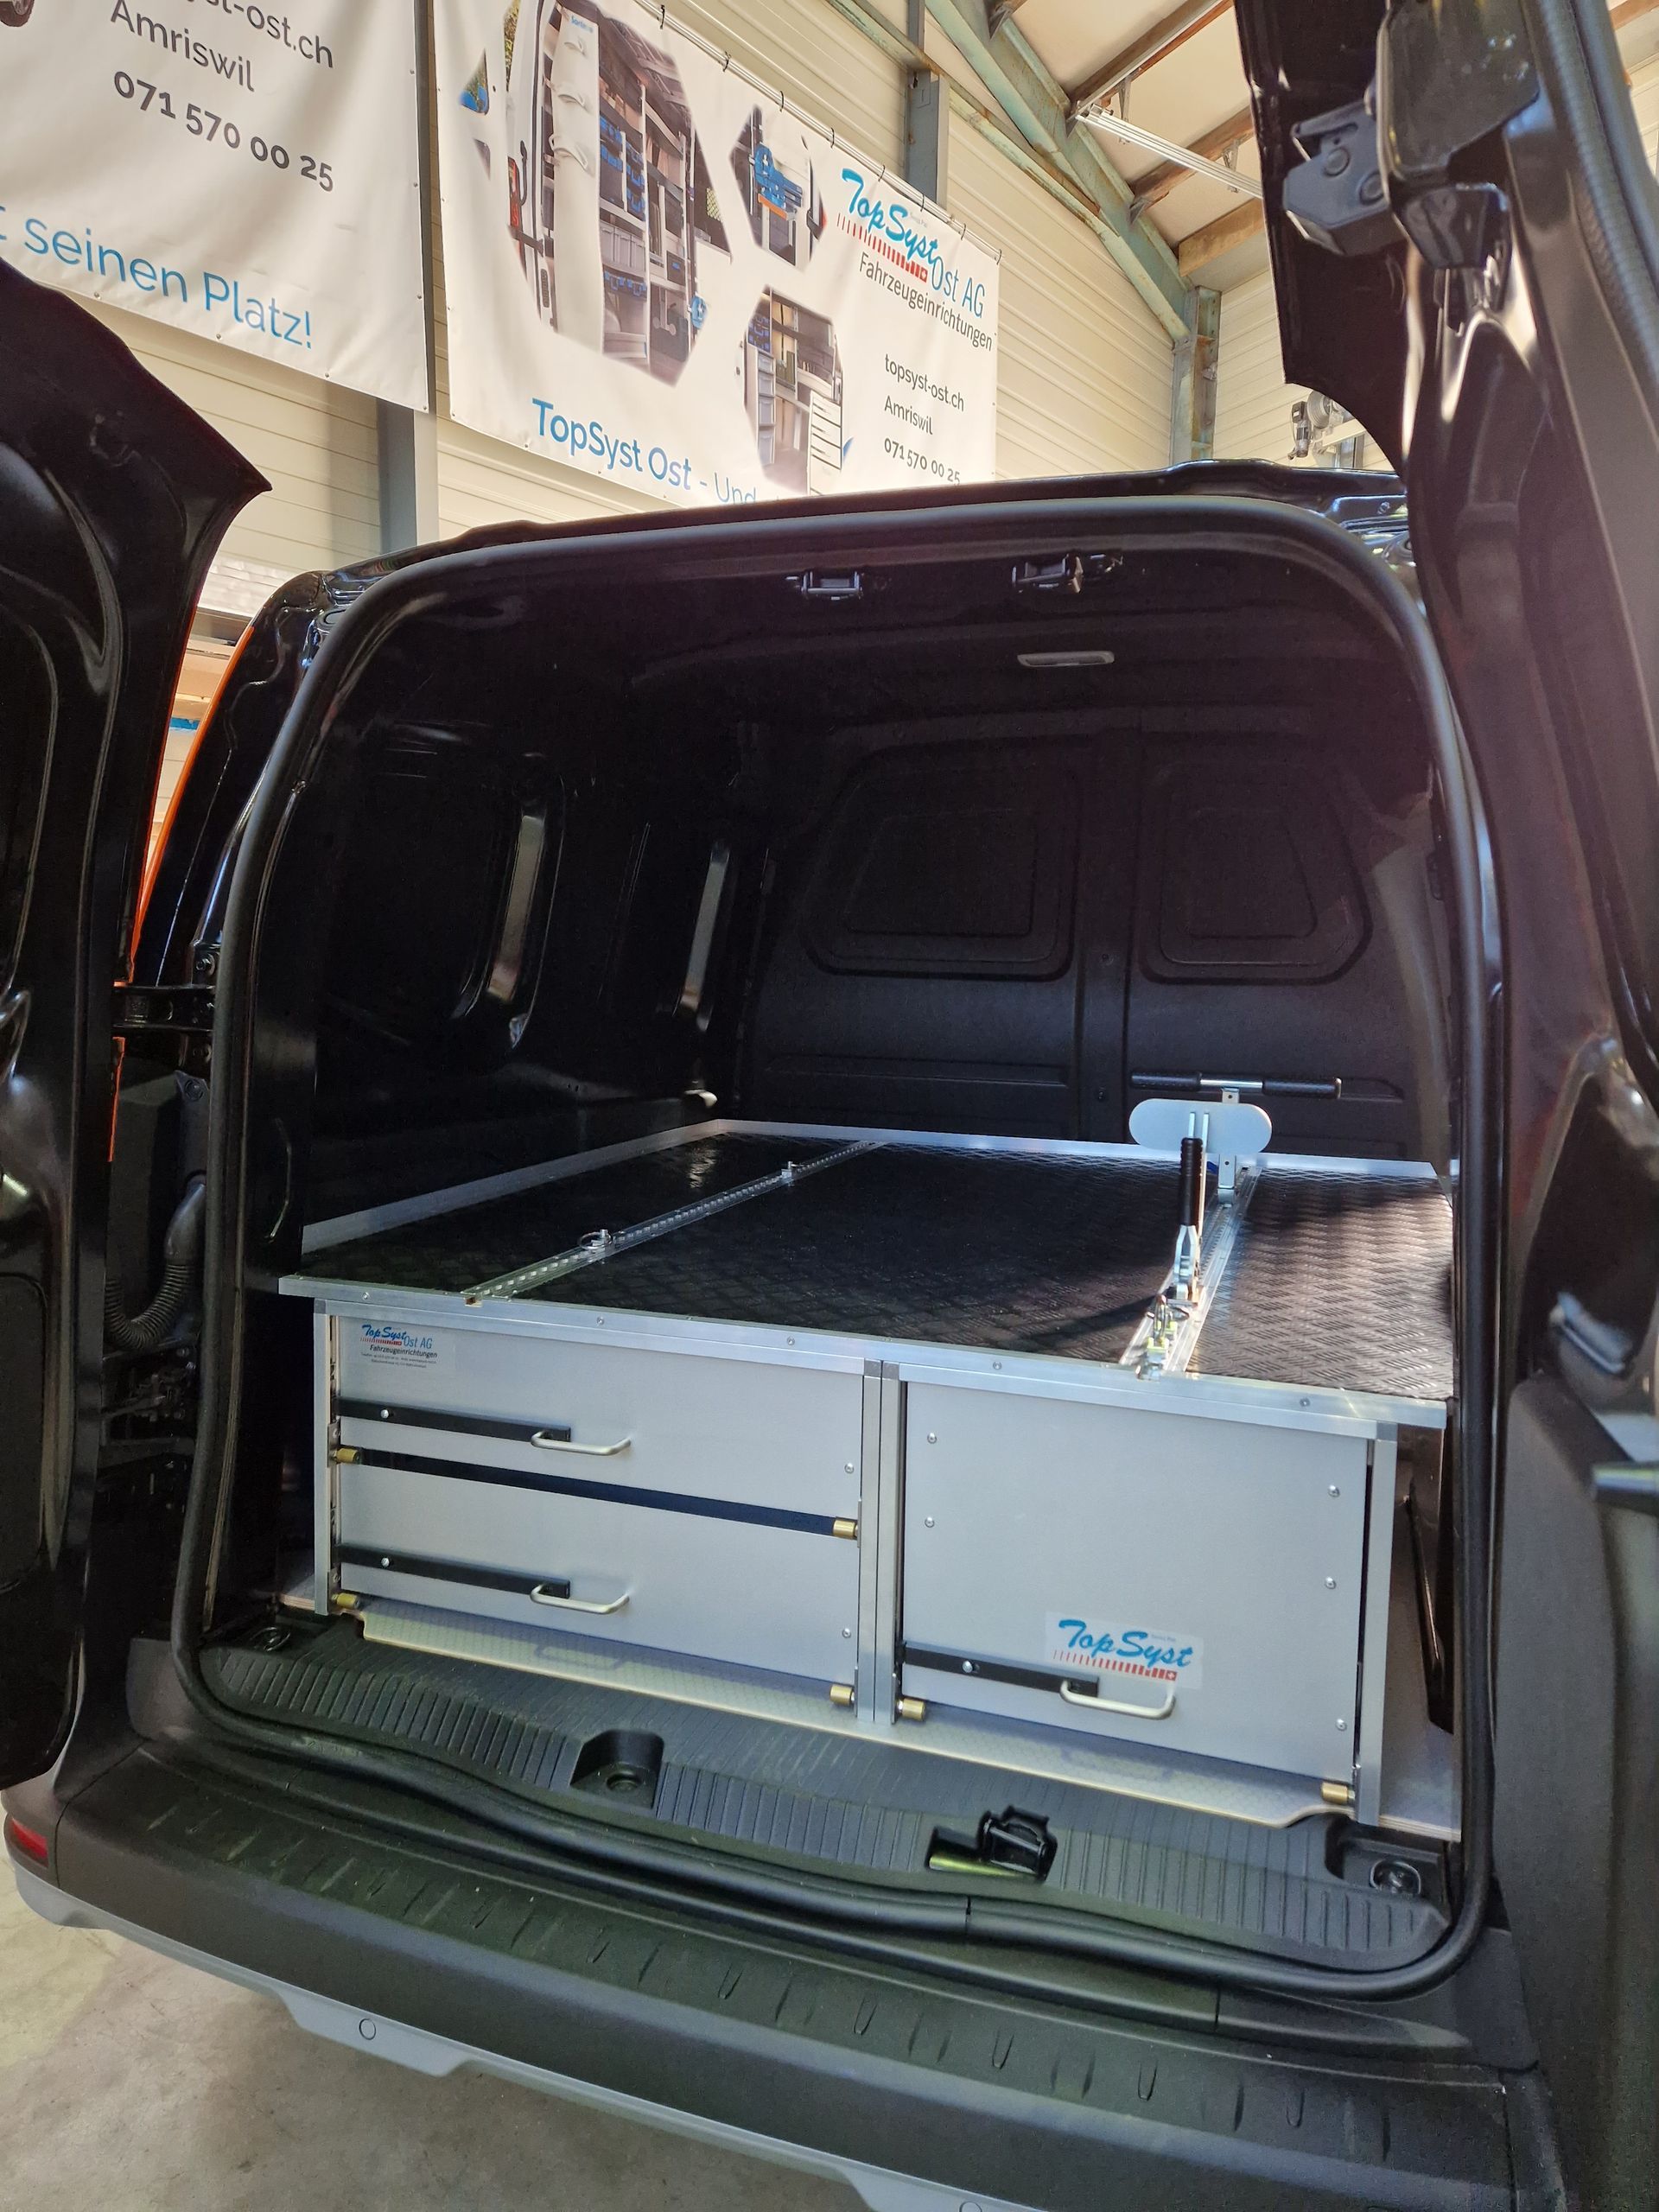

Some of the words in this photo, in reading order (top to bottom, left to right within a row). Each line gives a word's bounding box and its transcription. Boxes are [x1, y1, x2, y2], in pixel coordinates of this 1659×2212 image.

[111, 0, 254, 92] Amriswil
[187, 0, 333, 68] -ost.ch
[114, 71, 175, 118] 071
[186, 103, 240, 149] 570
[250, 136, 289, 169] 00
[300, 155, 334, 192] 25
[842, 168, 938, 264] TopSyst
[931, 256, 959, 302] Ost
[962, 276, 985, 318] AG
[24, 218, 188, 302] seinen
[204, 271, 312, 349] Platz!
[859, 251, 993, 351] Fahrzeugeinrichtungen
[884, 395, 933, 435] Amriswil
[885, 353, 964, 412] topsyst-ost.ch
[532, 397, 643, 470] TopSyst
[648, 447, 692, 490] Ost
[714, 472, 756, 505] Und
[884, 437, 905, 459] 071
[907, 449, 927, 470] 570
[931, 460, 944, 478] 00
[947, 468, 961, 486] 25
[361, 1324, 407, 1341] TopSyst
[404, 1335, 417, 1348] Ost
[420, 1337, 433, 1350] AG
[370, 1344, 438, 1359] Fahrzeugeinrichtungen
[1058, 1619, 1193, 1668] TopSyst
